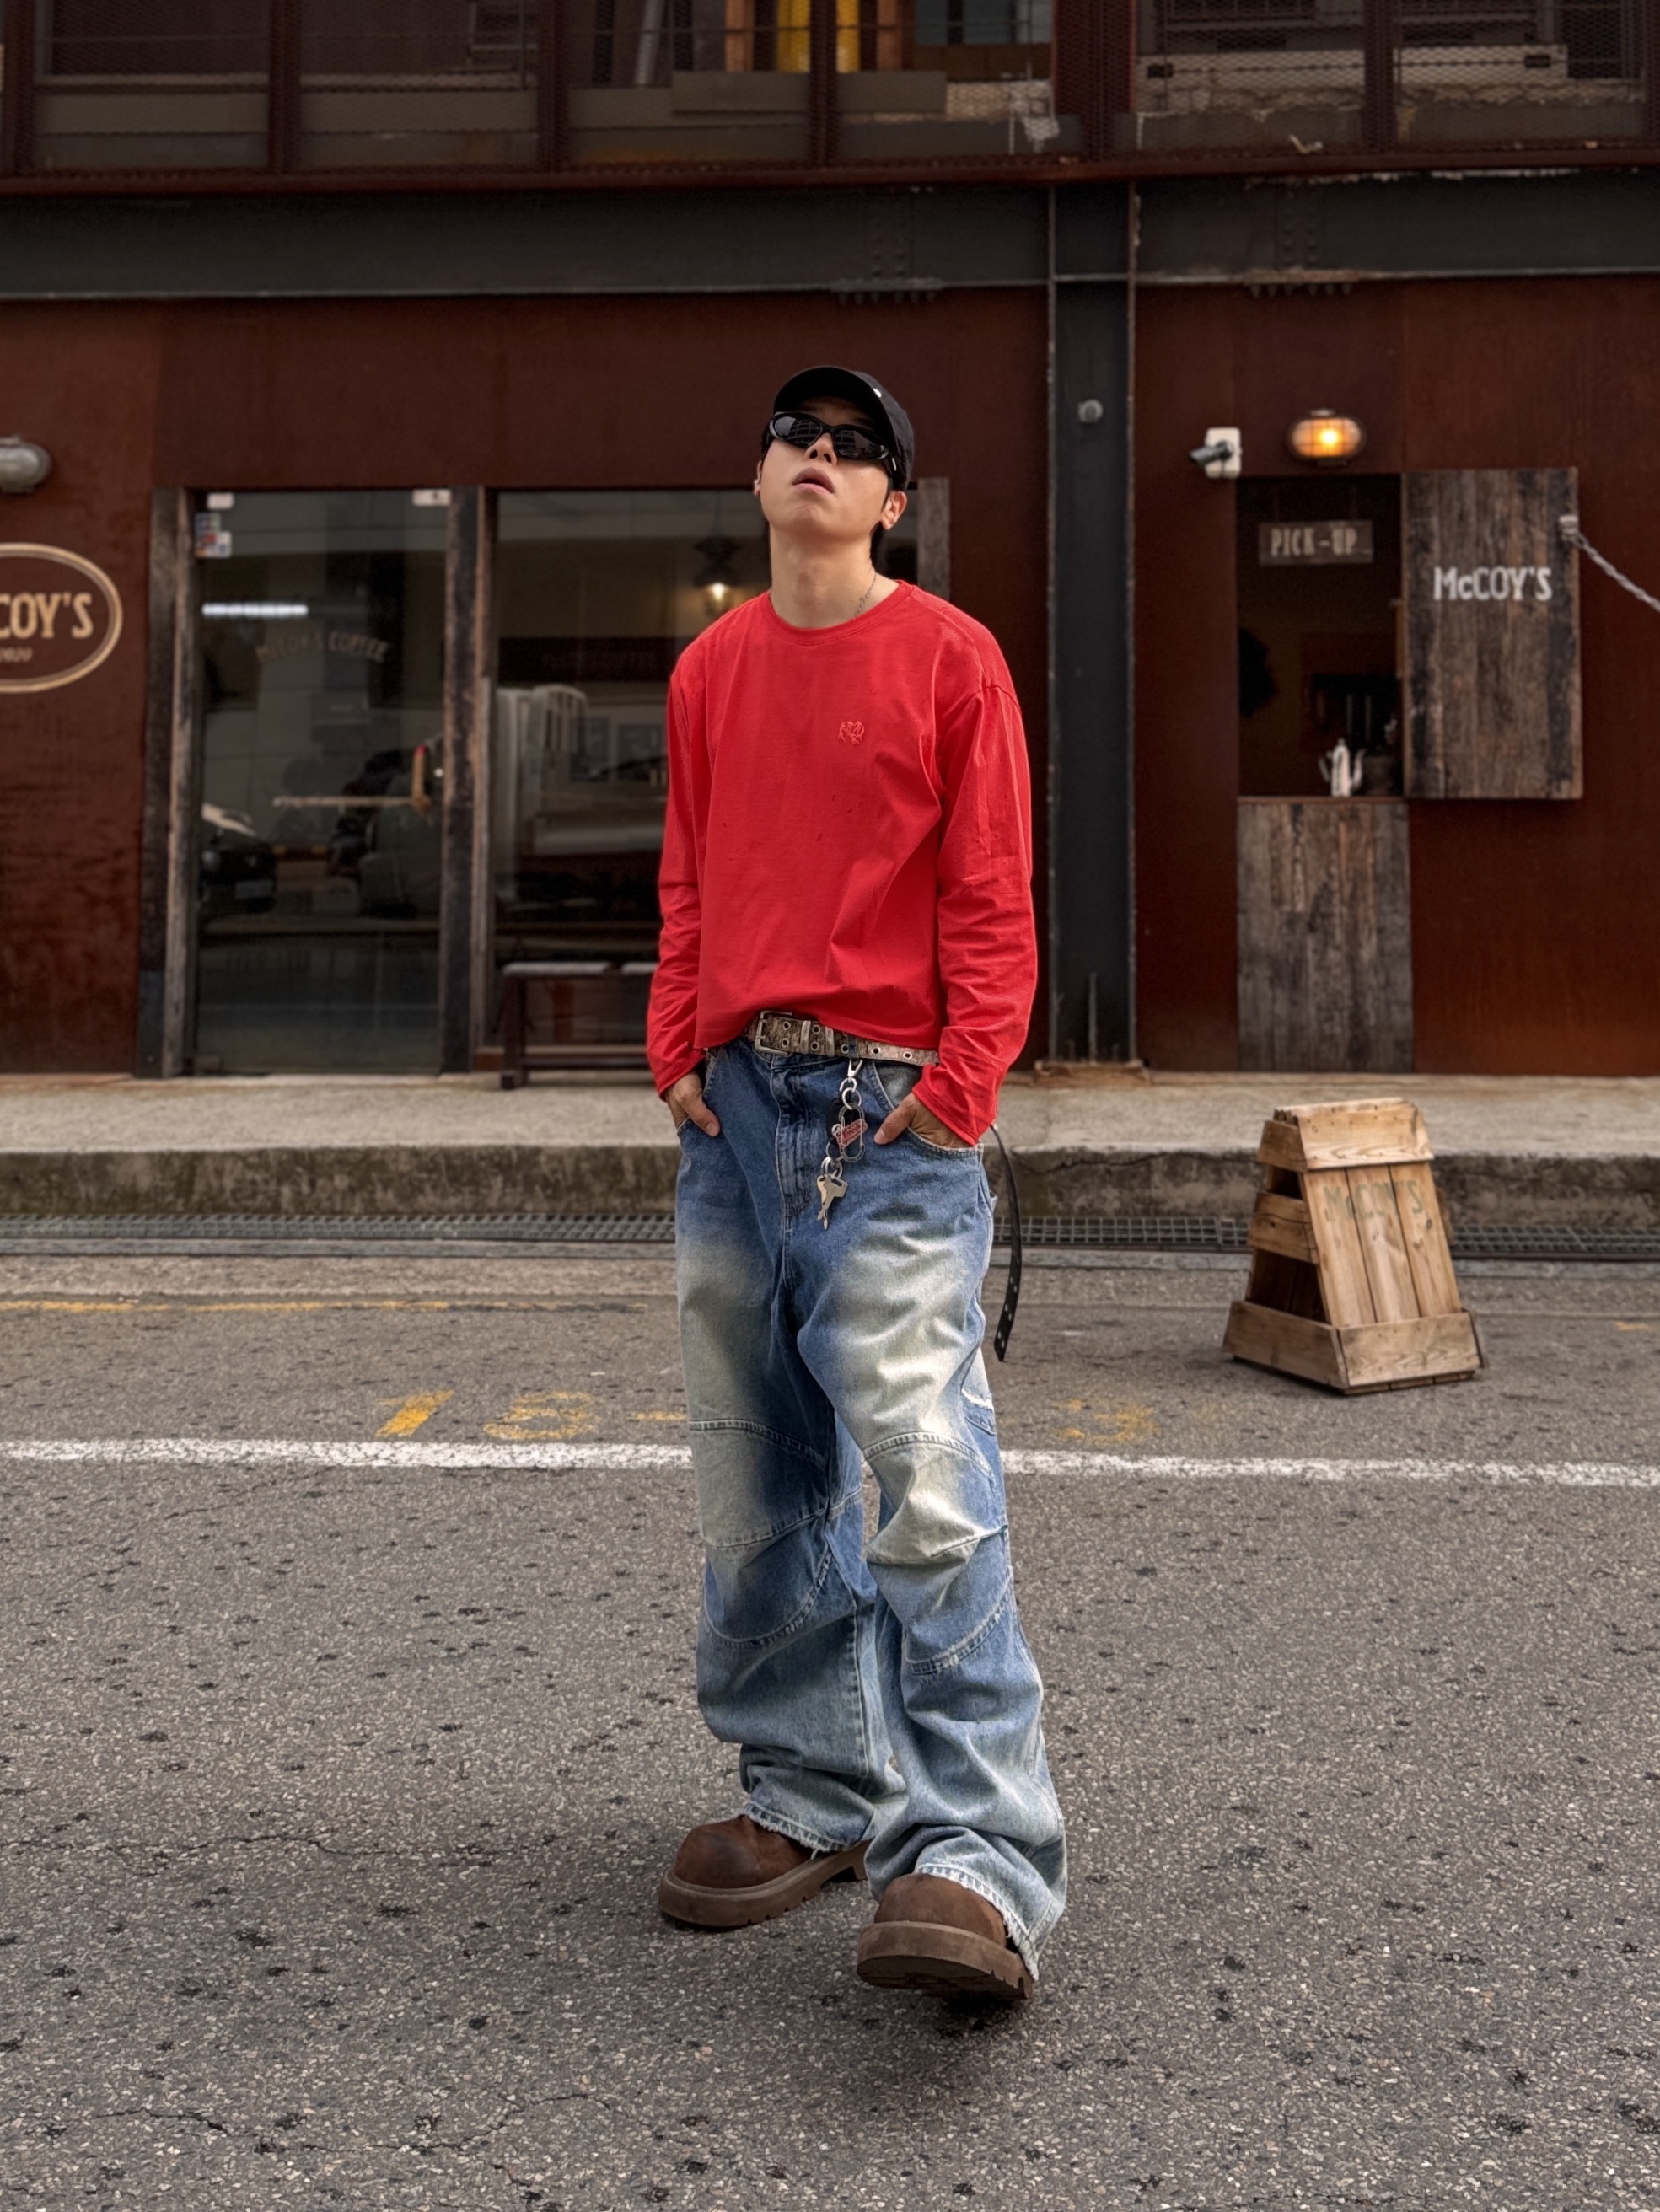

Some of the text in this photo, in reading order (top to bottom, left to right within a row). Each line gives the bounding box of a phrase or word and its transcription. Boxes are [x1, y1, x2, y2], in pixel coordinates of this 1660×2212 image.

[1271, 527, 1357, 556] PICK-UP
[1434, 566, 1553, 601] McCOY'S
[1322, 1179, 1424, 1222] McCOY'S
